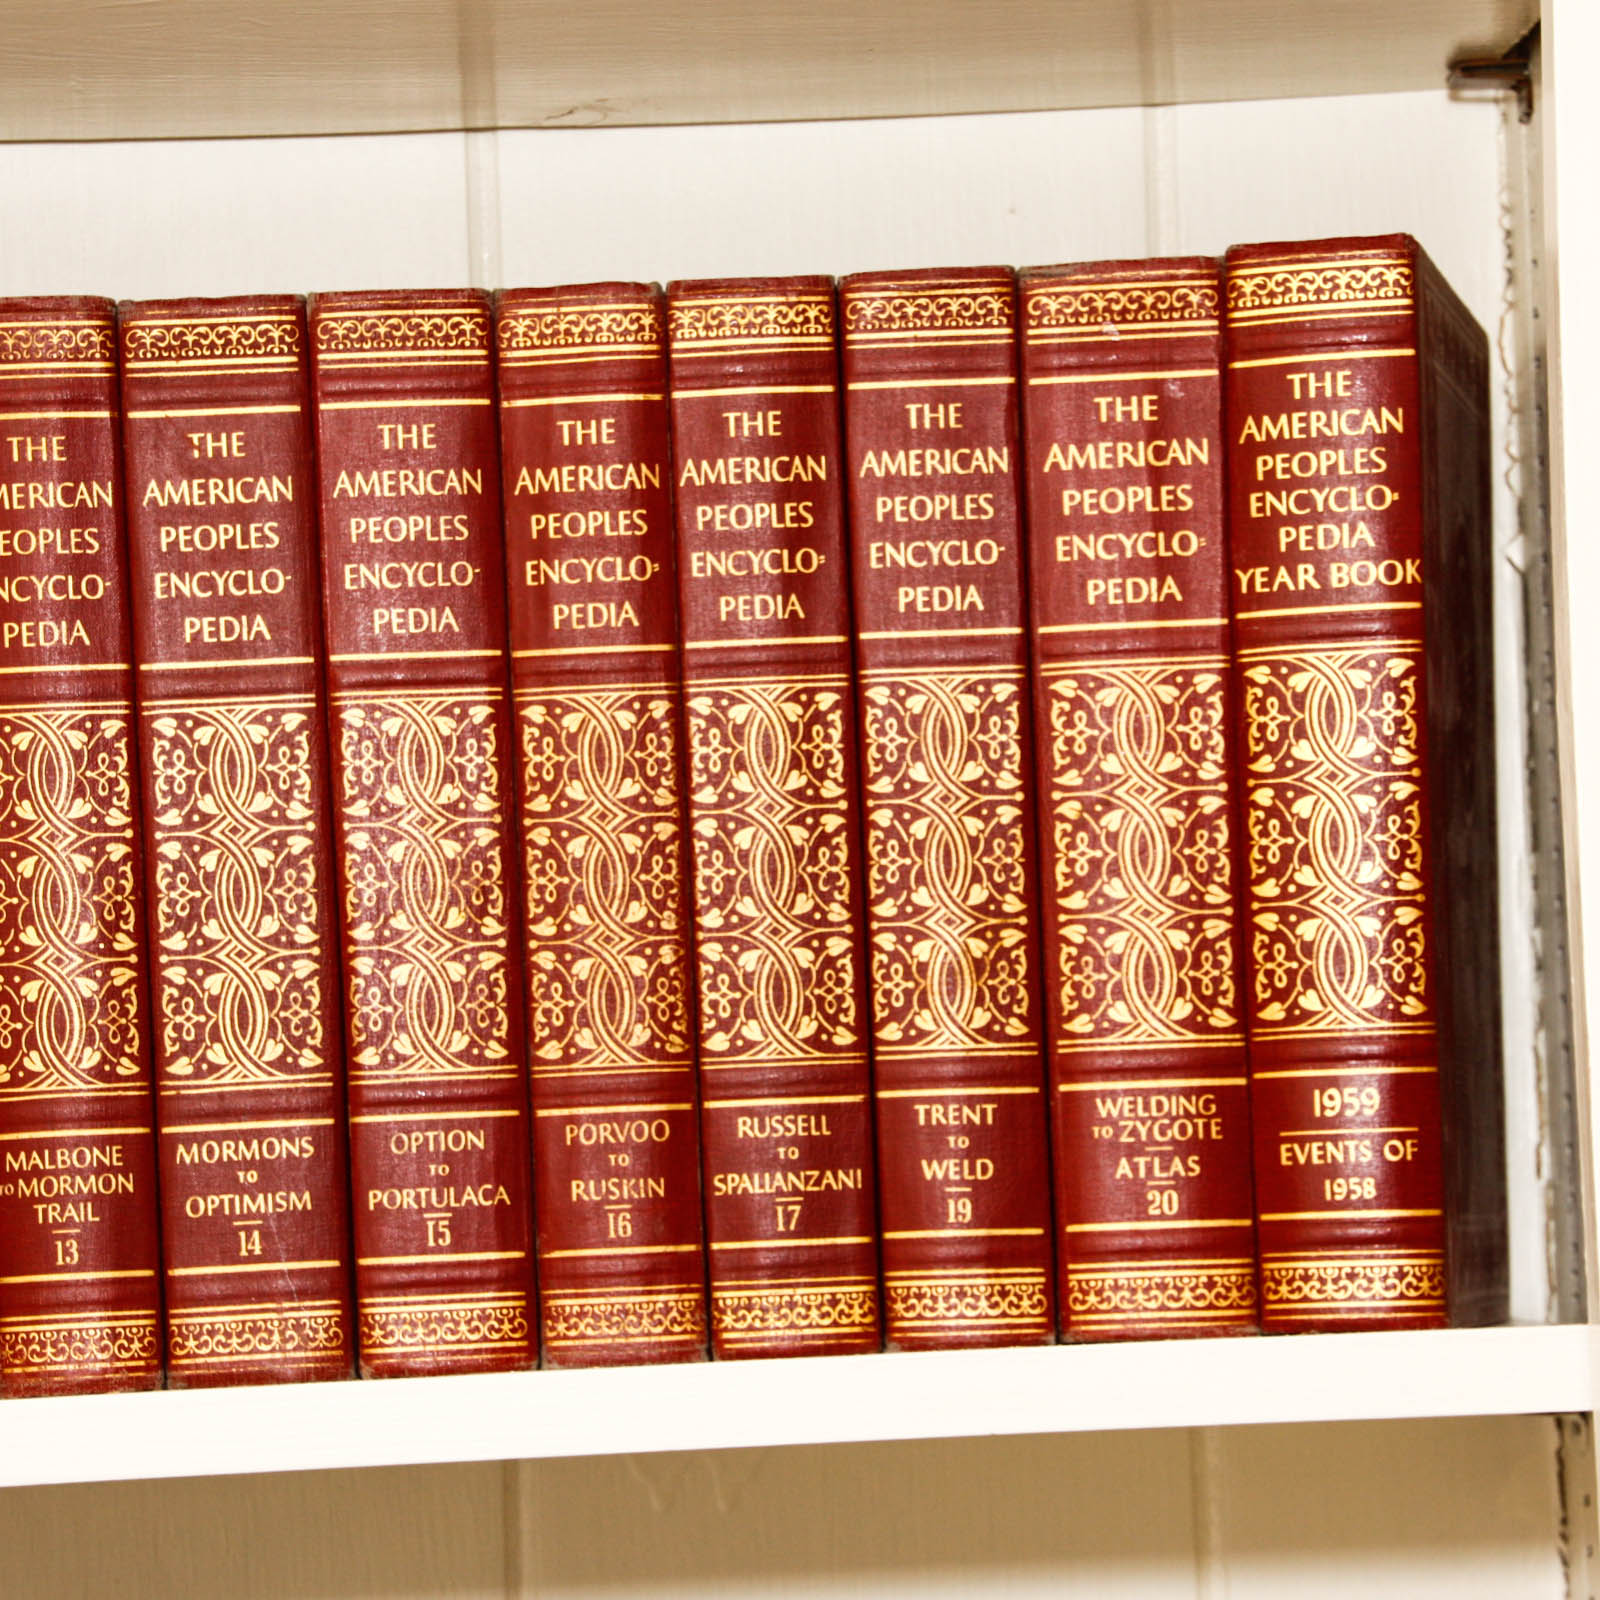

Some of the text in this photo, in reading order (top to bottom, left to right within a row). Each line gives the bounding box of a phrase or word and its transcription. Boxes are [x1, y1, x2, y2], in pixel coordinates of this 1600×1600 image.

[1287, 371, 1349, 401] THE
[905, 403, 962, 429] THE
[1093, 395, 1157, 422] THE
[377, 424, 436, 450] THE
[557, 418, 615, 445] THE
[723, 411, 781, 437] THE
[1239, 407, 1403, 444] AMERICAN
[7, 436, 66, 462] THE
[188, 432, 245, 458] THE
[1044, 438, 1208, 472] AMERICAN
[680, 456, 826, 487] AMERICAN
[860, 447, 1008, 478] AMERICAN
[1257, 449, 1387, 481] PEOPLES
[143, 475, 292, 508] AMERICAN
[333, 469, 481, 498] AMERICAN
[515, 463, 659, 495] AMERICAN
[876, 493, 994, 522] PEOPLES
[1063, 484, 1193, 515] PEOPLES
[350, 515, 468, 543] PEOPLES
[531, 510, 647, 539] PEOPLES
[696, 502, 813, 531] PEOPLES
[160, 522, 279, 552] PEOPLES
[1278, 522, 1374, 553] PEDIA
[1236, 557, 1421, 593] YEAR BOOK
[898, 584, 984, 613] PEDIA
[1087, 576, 1182, 605] PEDIA
[373, 605, 459, 635] PEDIA
[553, 601, 639, 629] PEDIA
[720, 594, 804, 624] PEDIA
[4, 618, 90, 648] PEDIA
[183, 614, 271, 643] PEDIA
[914, 1104, 996, 1126] TRENT
[1096, 1094, 1215, 1119] WELDING
[1312, 1088, 1380, 1118] 1959
[566, 1120, 669, 1145] PORVOO
[737, 1115, 830, 1138] RUSSELL
[1093, 1119, 1221, 1142] TO ZYGOTE
[177, 1136, 314, 1164] MORMONS
[390, 1130, 484, 1155] OPTION
[777, 1147, 799, 1159] TO
[948, 1136, 969, 1148] TO
[1280, 1138, 1419, 1167] EVENTS OF
[7, 1146, 122, 1171] MALBONE
[429, 1164, 449, 1176] TO
[609, 1154, 630, 1166] TO
[921, 1159, 993, 1180] WELD
[1115, 1156, 1200, 1179] ATLAS
[19, 1174, 133, 1197] MORMON
[237, 1170, 258, 1183] TO
[572, 1178, 664, 1201] RUSKIN
[1324, 1176, 1376, 1201] 1958
[186, 1191, 311, 1217] OPTIMISM
[369, 1184, 510, 1210] PORTULACA
[1147, 1190, 1178, 1215] 20
[34, 1202, 99, 1223] TRAIL
[776, 1205, 801, 1231] 17
[948, 1198, 971, 1223] 19
[427, 1220, 451, 1247] 15
[608, 1212, 632, 1238] 16
[56, 1239, 78, 1265] 13
[239, 1230, 262, 1256] 14
